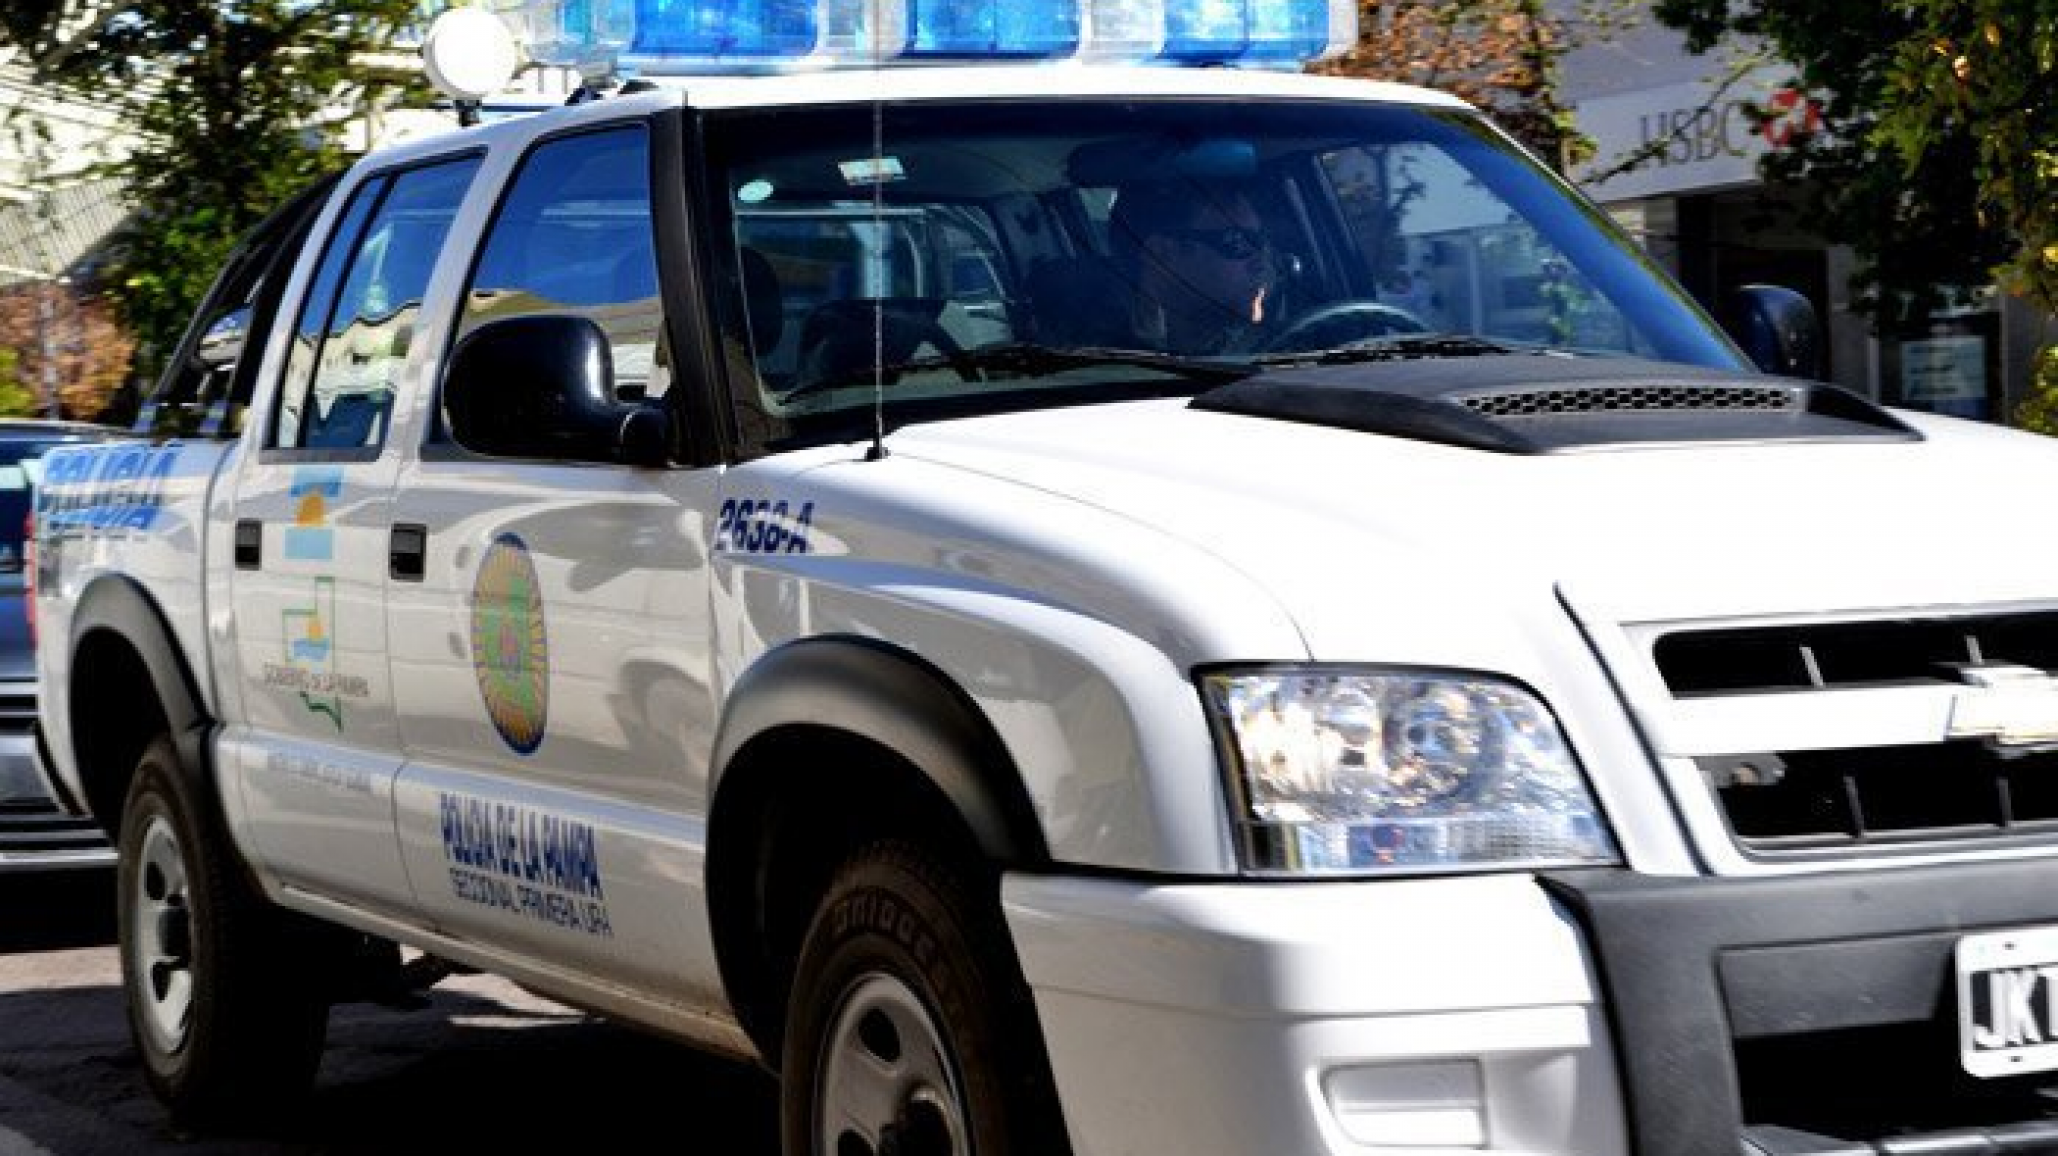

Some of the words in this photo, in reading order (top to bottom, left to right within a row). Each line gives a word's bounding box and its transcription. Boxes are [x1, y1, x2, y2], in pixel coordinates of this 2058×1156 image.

[1640, 101, 1748, 167] HSBC
[495, 802, 521, 877] DE
[518, 810, 545, 884] LA
[541, 814, 604, 900] PAMPA
